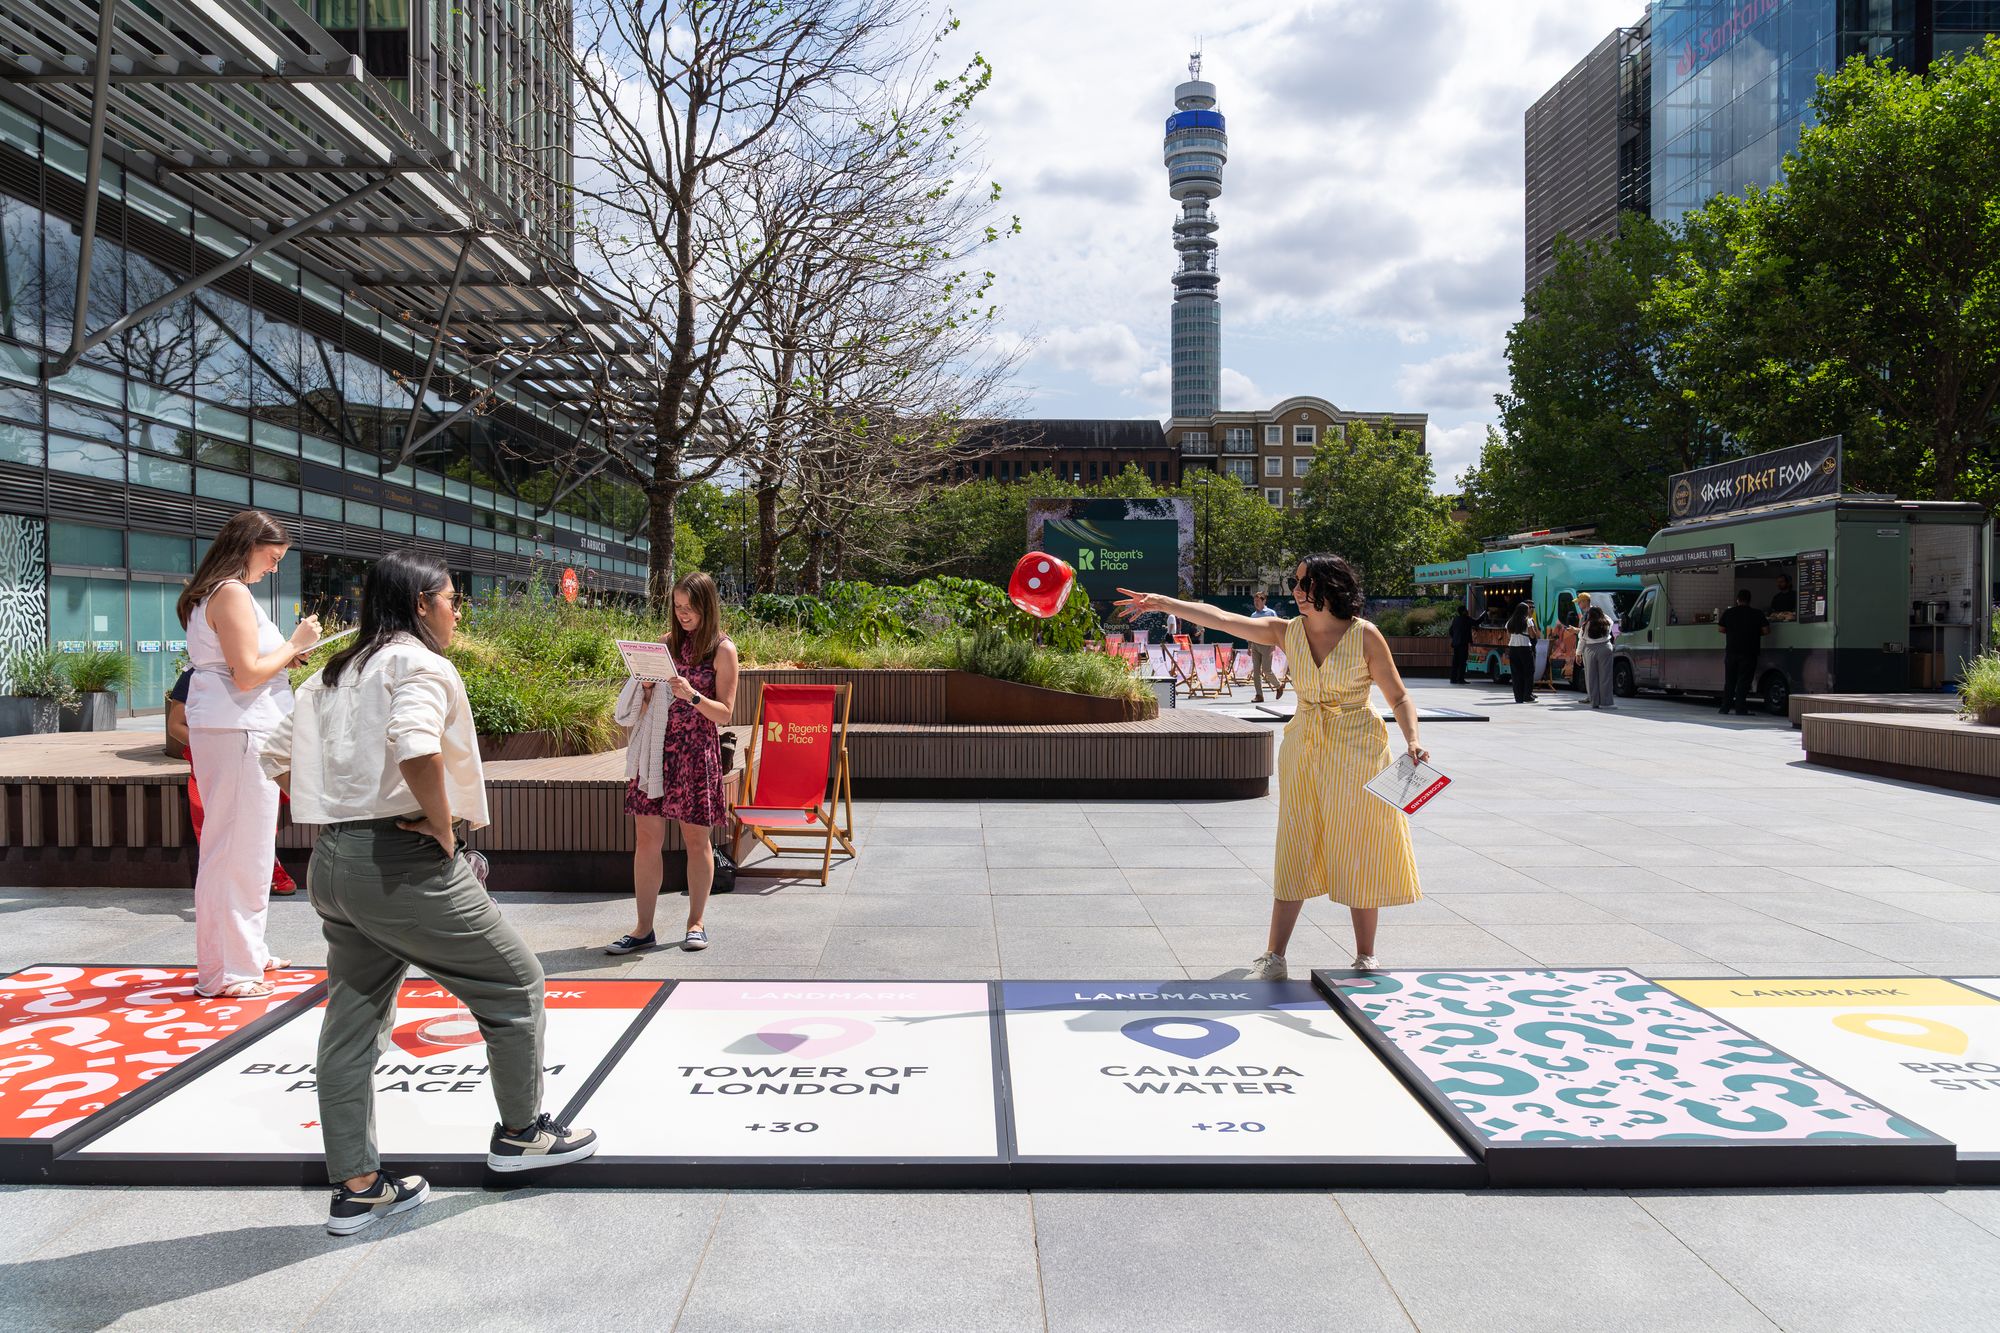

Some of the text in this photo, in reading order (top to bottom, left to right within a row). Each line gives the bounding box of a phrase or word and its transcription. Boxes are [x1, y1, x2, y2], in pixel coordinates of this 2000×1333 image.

[1701, 478, 1732, 502] GREEK
[1735, 468, 1776, 496] STREET
[1779, 460, 1812, 486] FOOD
[1100, 548, 1143, 561] Regent's
[1619, 549, 1727, 568] GYRO SOUVLAKI HALLOUMI FALAFEL FRIES
[1100, 560, 1128, 570] Place
[788, 722, 828, 736] Regent's
[788, 734, 813, 744] Place
[1410, 781, 1444, 809] SCORECARD
[405, 990, 587, 998] LARK
[740, 992, 918, 1000] LANDMARK
[1074, 992, 1252, 1000] LANDMARK
[1730, 988, 1910, 997] LANDMARK
[678, 1066, 929, 1078] TOWER OF
[1100, 1065, 1304, 1077] CANADA
[285, 1080, 482, 1092] PACE
[689, 1083, 900, 1095] LONDON
[1122, 1082, 1297, 1094] WATER
[745, 1121, 819, 1133] +30
[1192, 1121, 1266, 1133] +20
